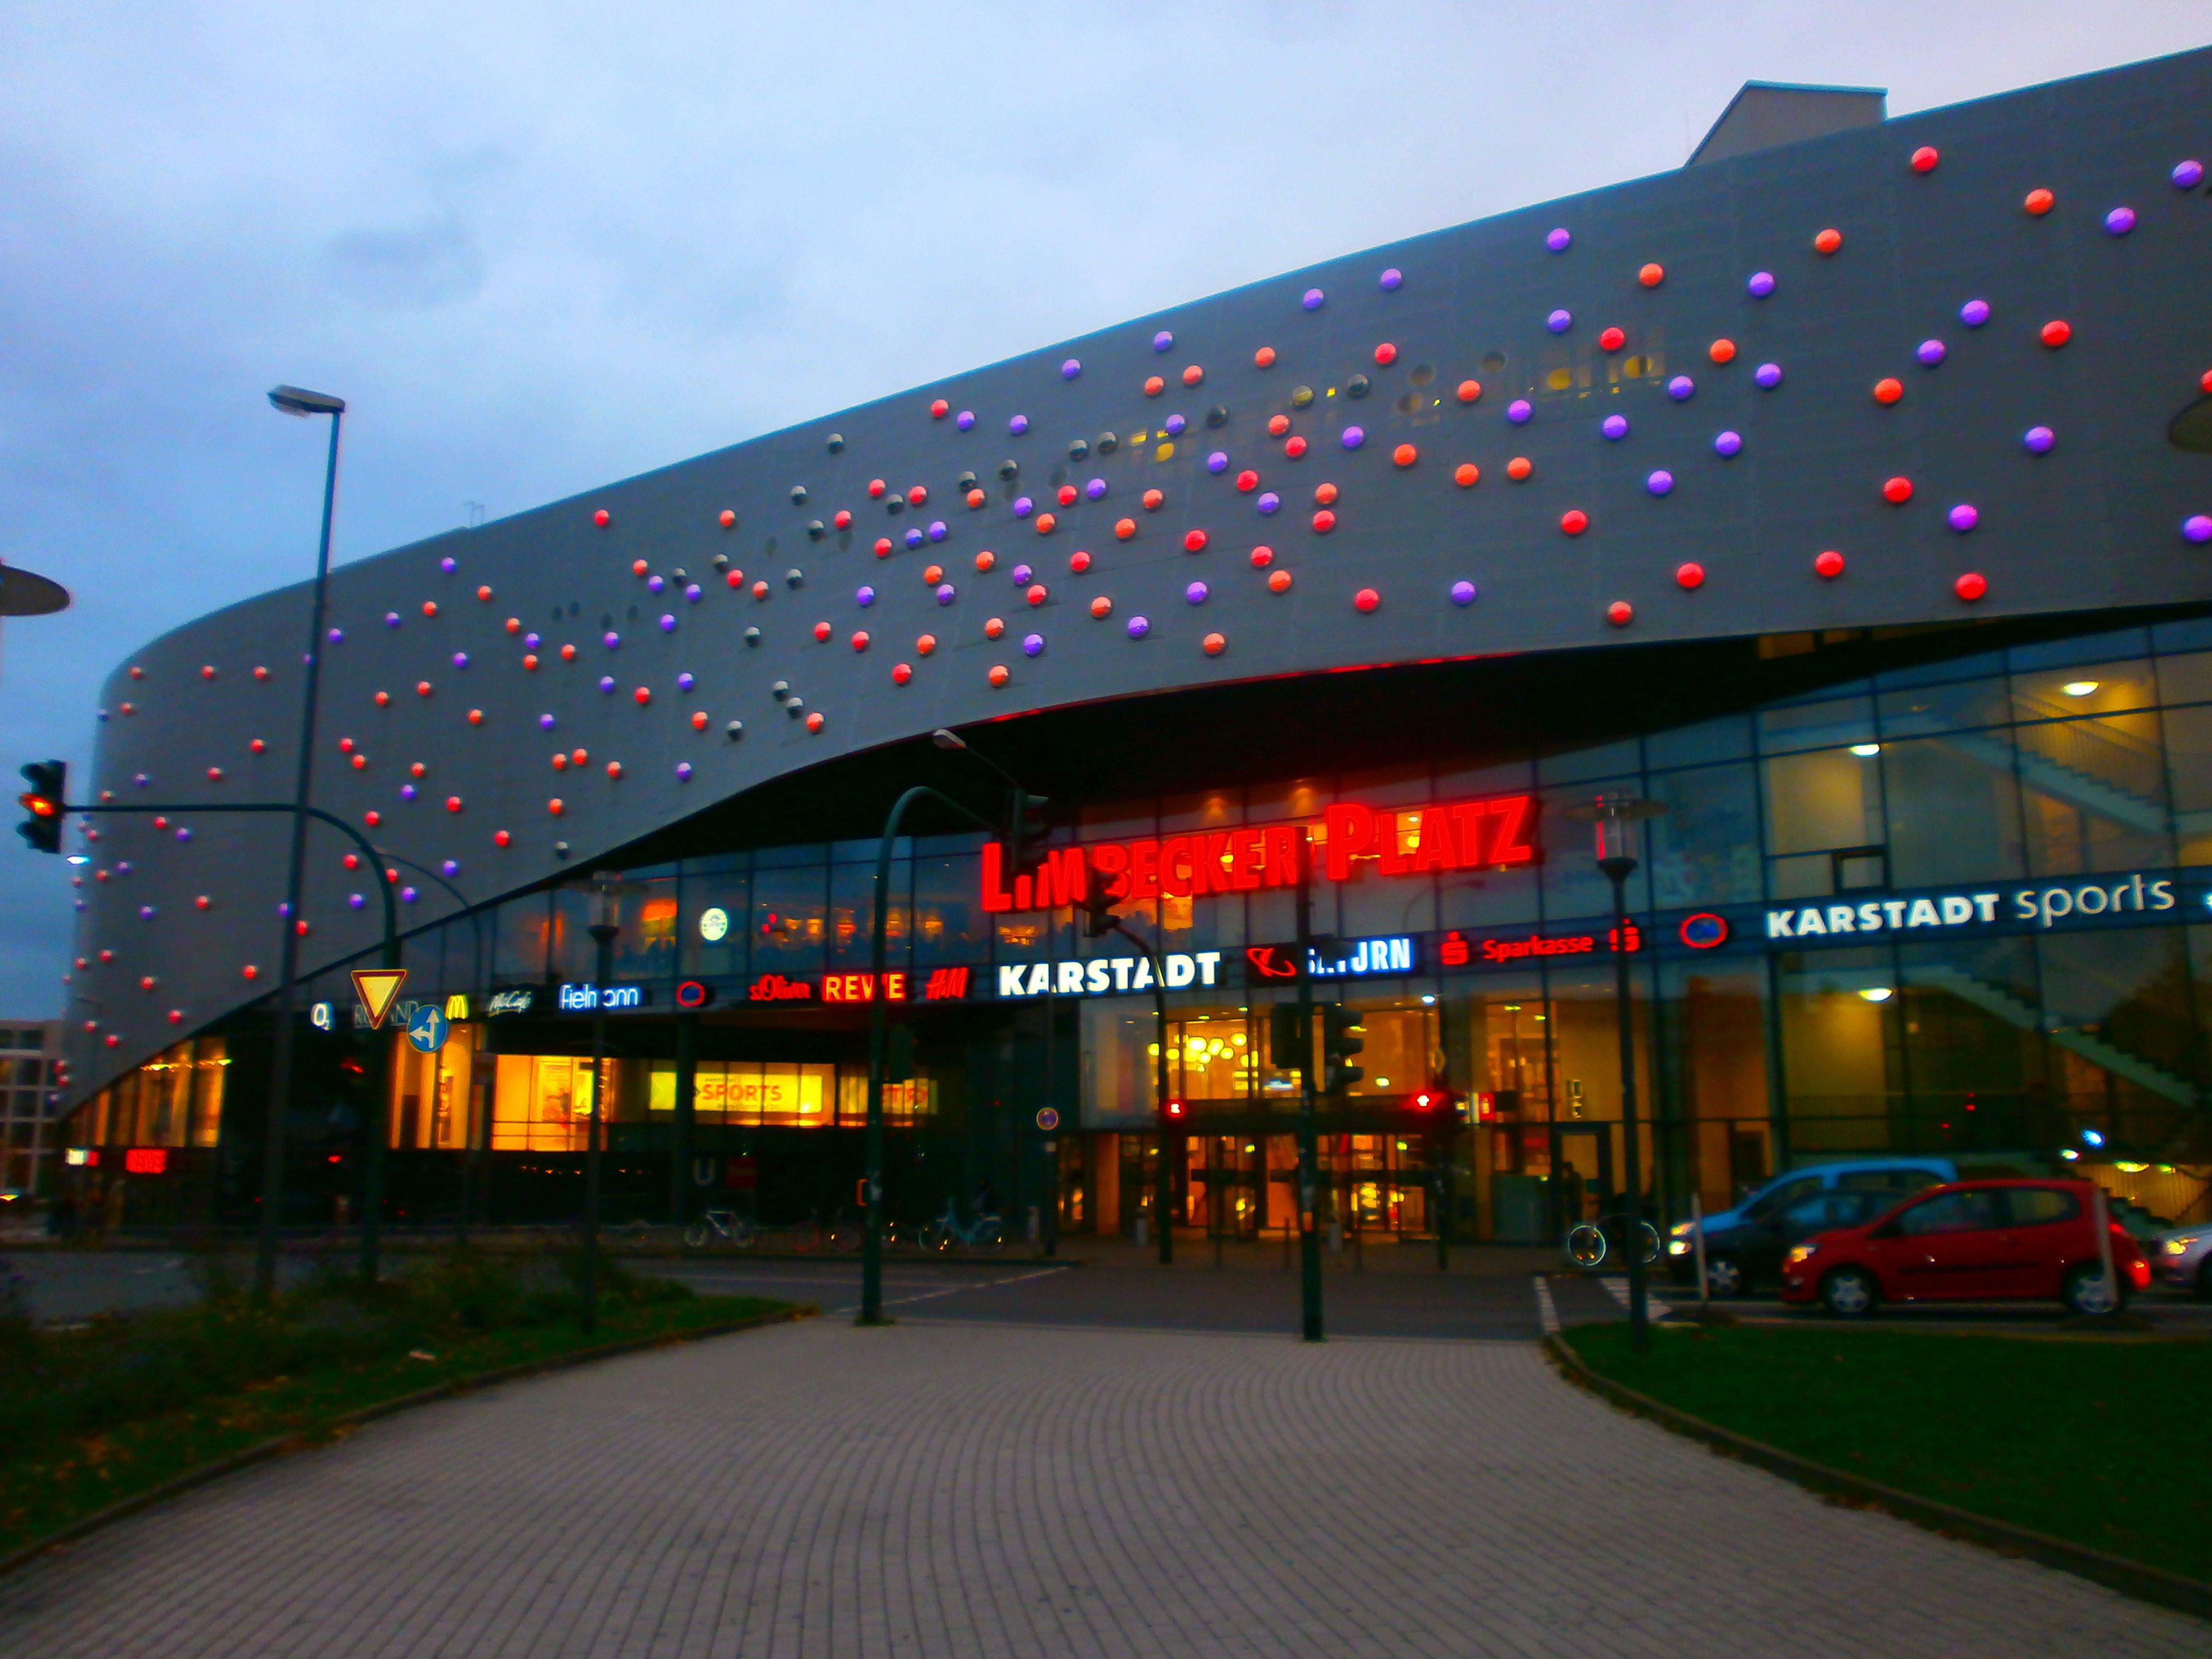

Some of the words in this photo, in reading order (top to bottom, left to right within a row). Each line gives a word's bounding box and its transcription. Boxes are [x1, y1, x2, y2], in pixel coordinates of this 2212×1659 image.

[1325, 795, 1532, 881] PLATZ
[1766, 893, 2000, 939] KARSTADT
[2015, 874, 2175, 929] sports
[1482, 935, 1594, 963] Sparkasse
[998, 951, 1221, 996] KARSTADT
[702, 1084, 783, 1102] SPORTS
